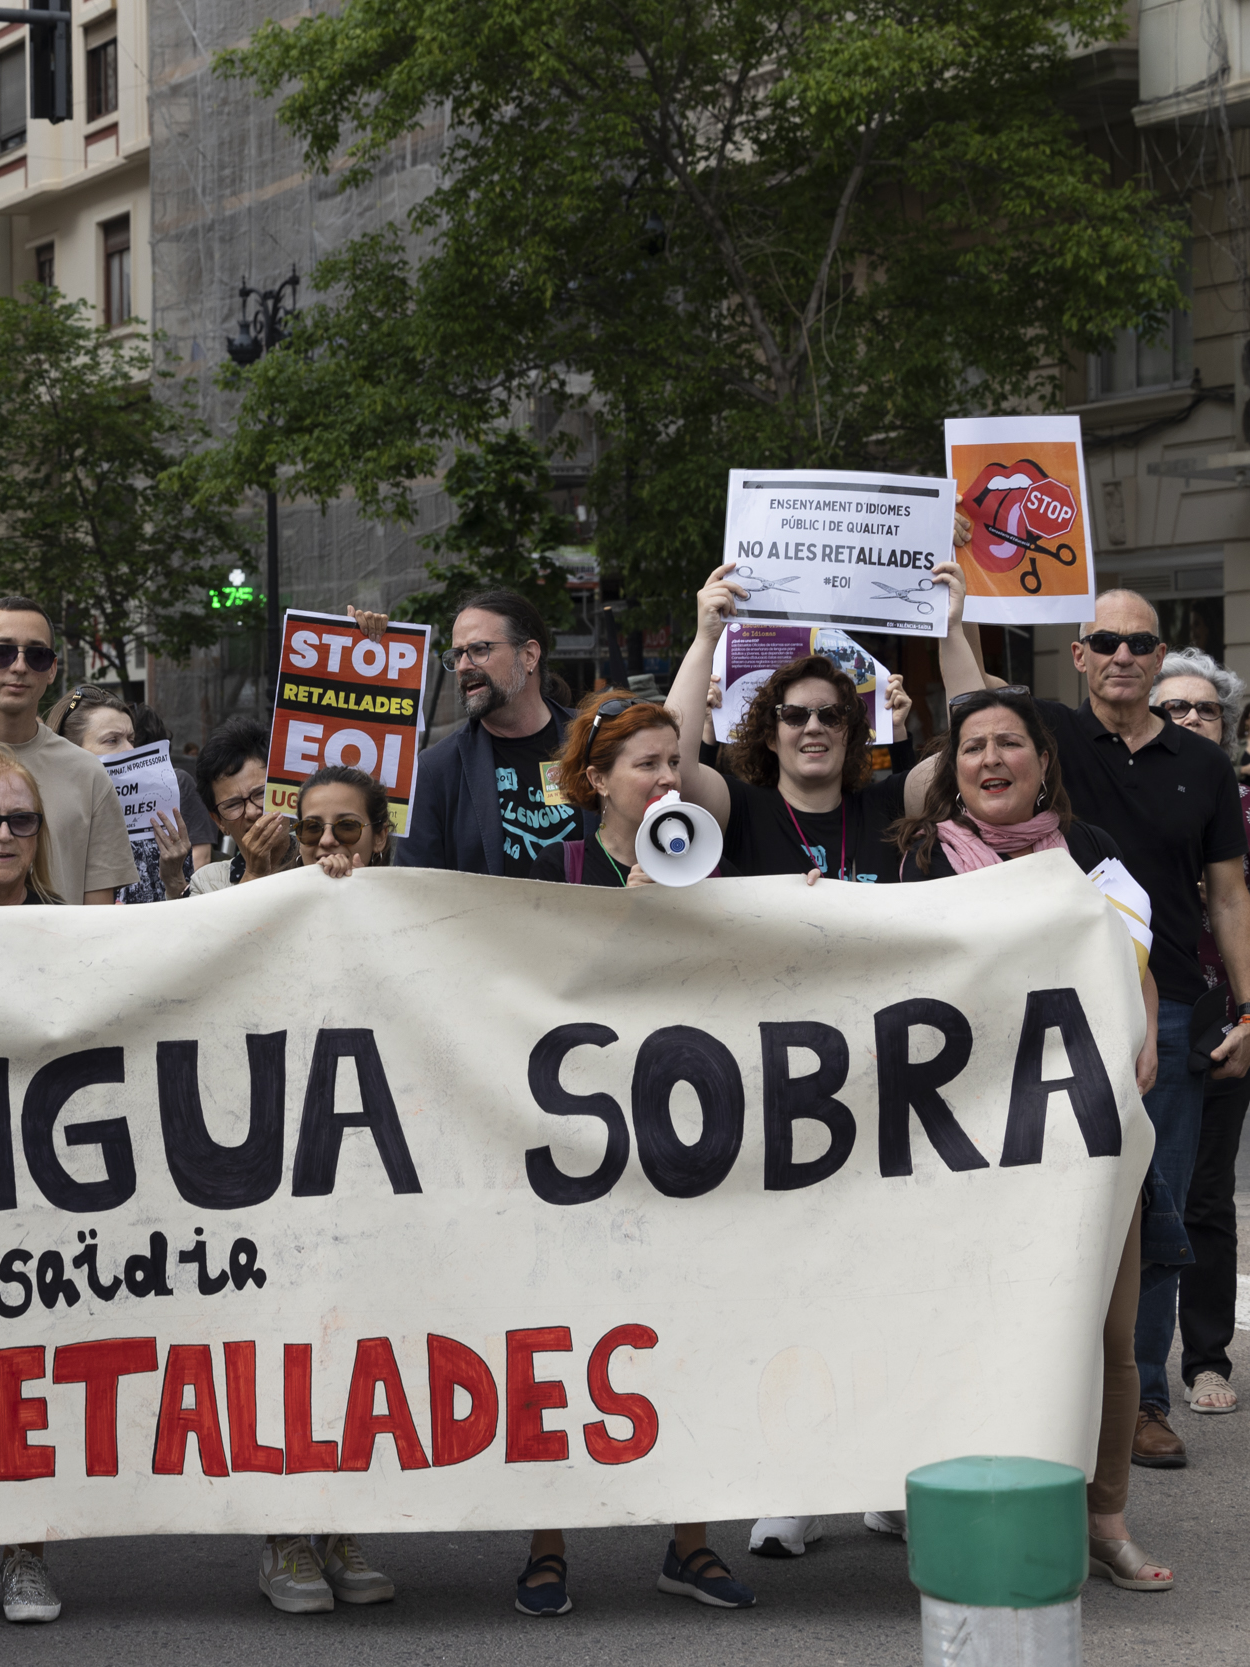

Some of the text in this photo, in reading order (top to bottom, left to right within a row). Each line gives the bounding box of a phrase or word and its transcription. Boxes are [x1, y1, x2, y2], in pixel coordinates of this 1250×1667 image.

[769, 499, 911, 517] ENSENYAMENT D'IDIOMES
[1027, 491, 1072, 523] STOP
[781, 516, 900, 536] PÚBLIC I DE QUALITAT
[737, 540, 935, 570] NO A LES RETALLADES
[823, 575, 851, 589] #EOI
[289, 630, 417, 680] STOP
[283, 683, 414, 716] RETALLADES
[132, 754, 168, 770] PROFESSORAT
[284, 719, 402, 789] EOI
[271, 789, 299, 809] UG
[527, 786, 545, 803] CA
[524, 987, 1123, 1206] SOBRA
